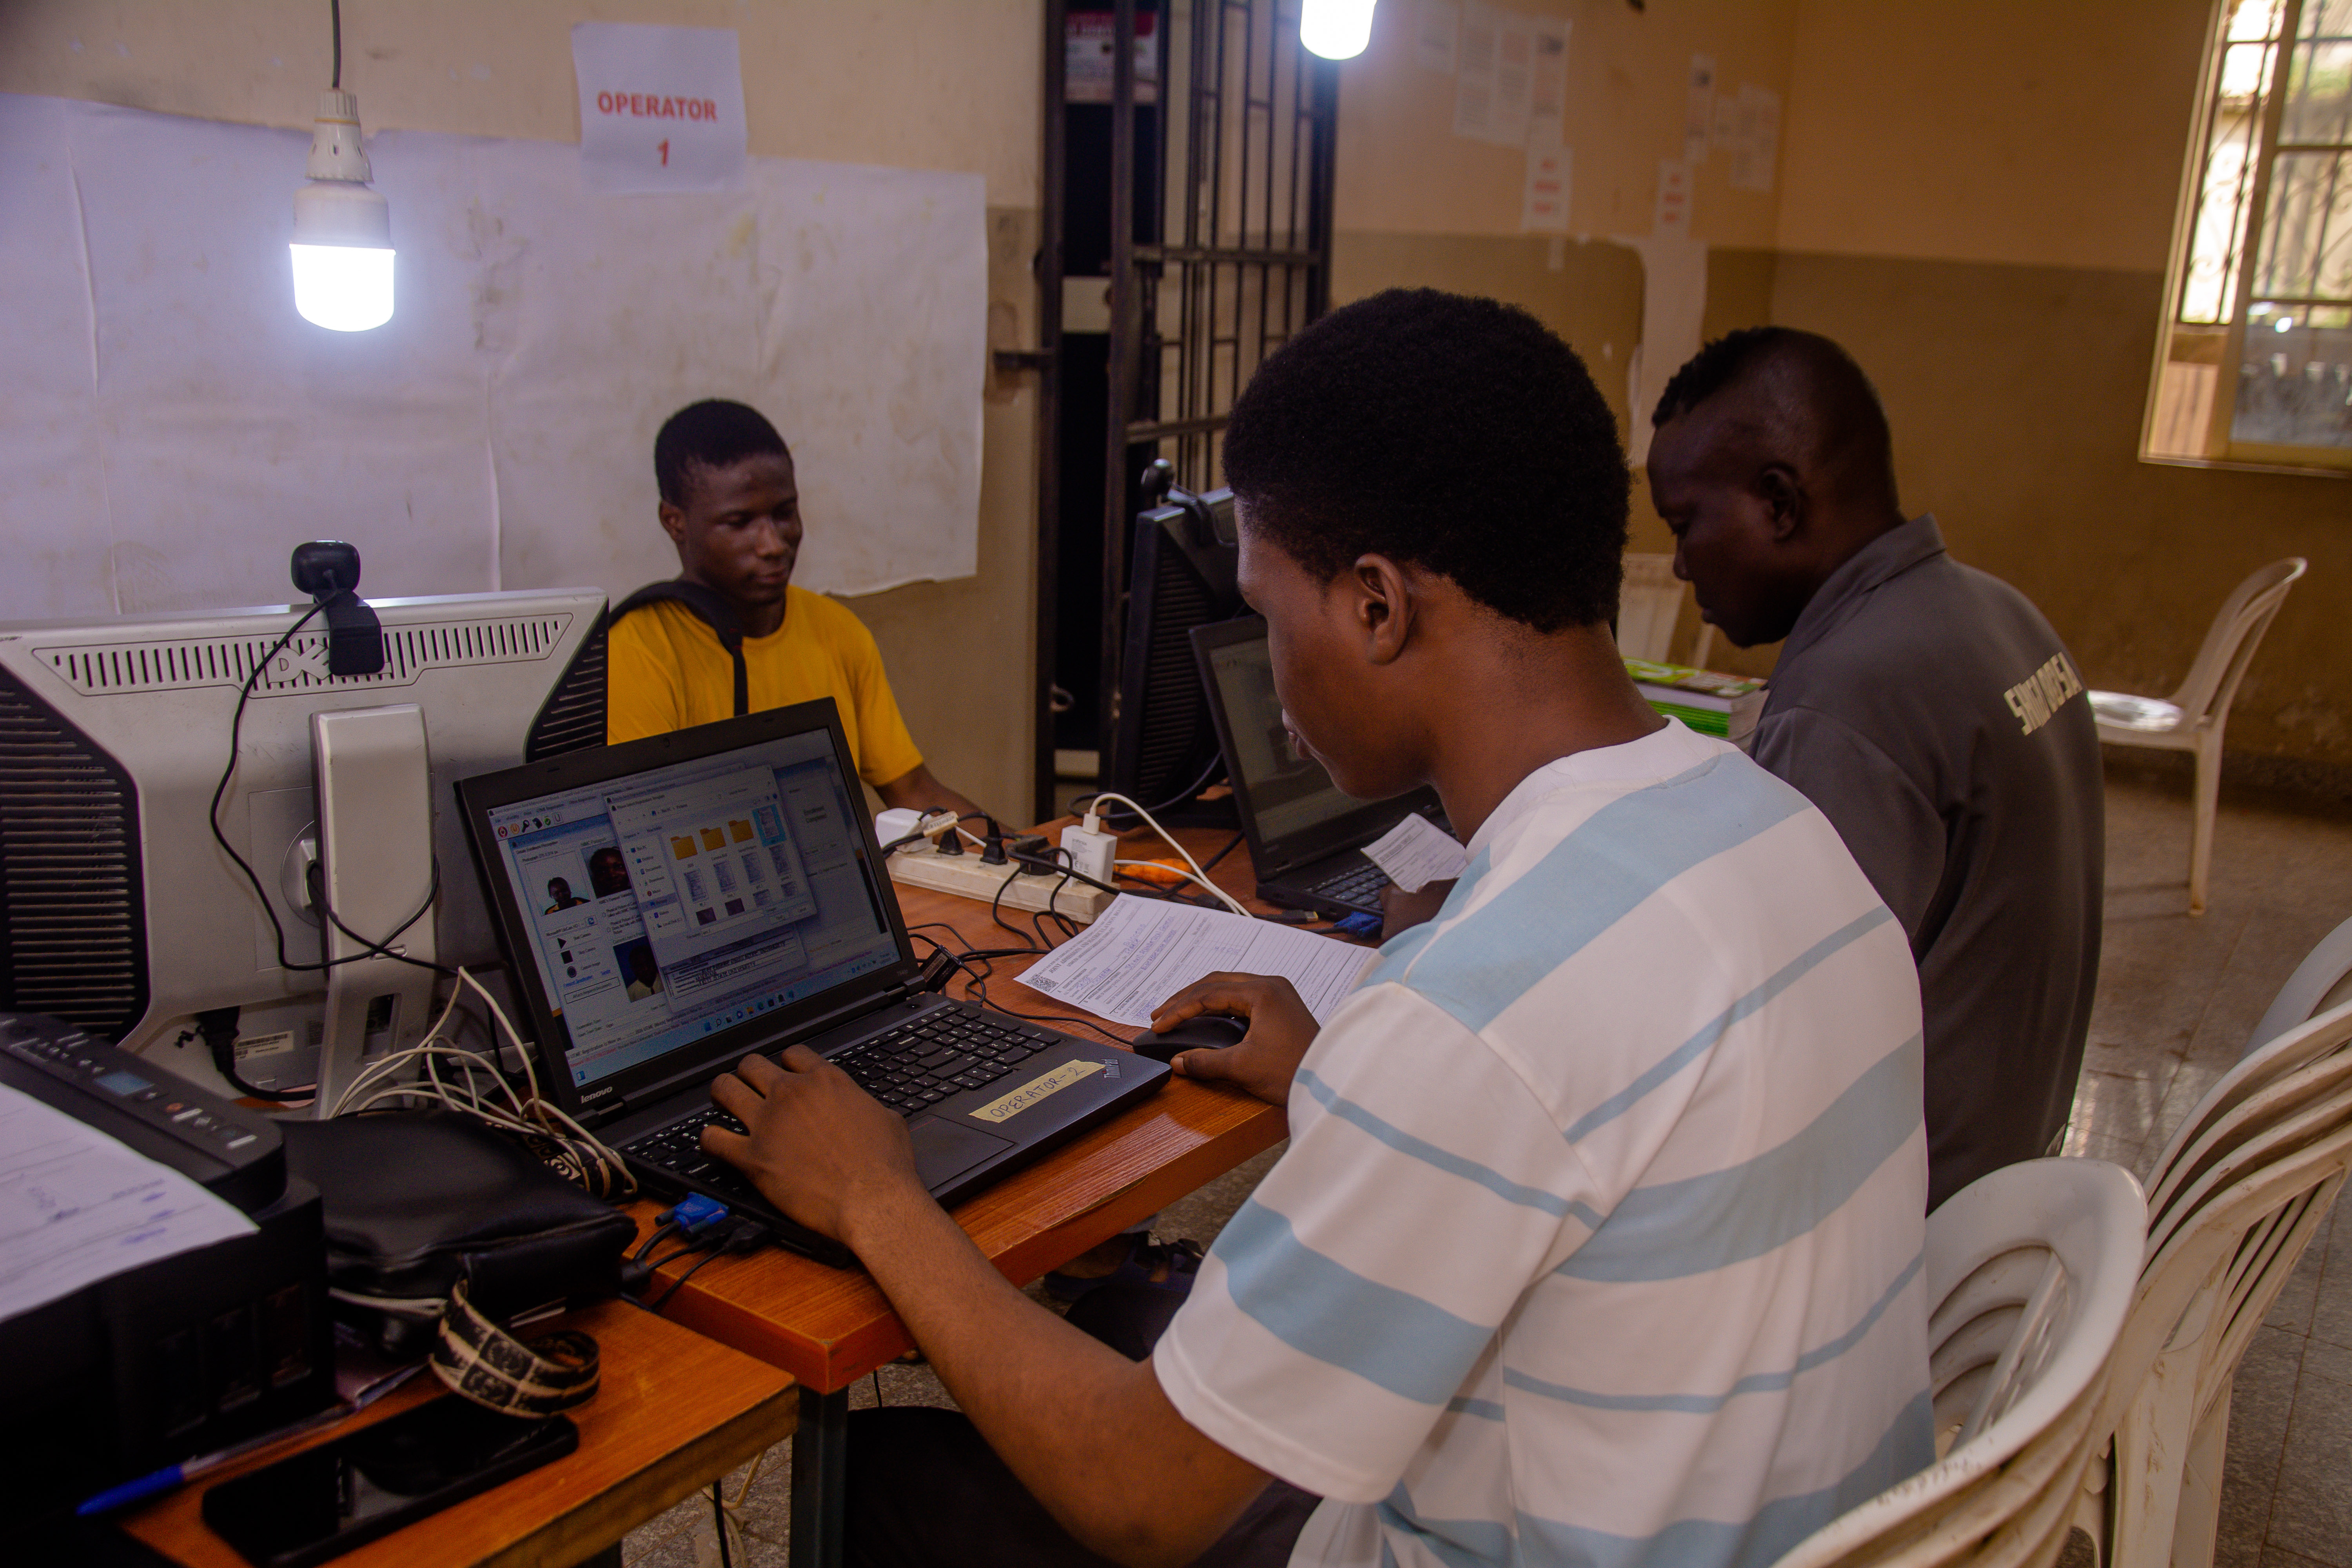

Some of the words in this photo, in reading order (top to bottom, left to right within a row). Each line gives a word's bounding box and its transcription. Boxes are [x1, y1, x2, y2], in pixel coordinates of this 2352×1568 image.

[597, 90, 718, 122] OPERATOR
[657, 138, 670, 167] 1
[1047, 963, 1063, 973] JOINT
[1058, 947, 1083, 964] ADMISSIONS
[1085, 916, 1117, 943] MATRICULATION
[1112, 902, 1127, 916] BOARD
[898, 1036, 915, 1045] Backspace
[1103, 1058, 1120, 1078] ThinkPad
[581, 1086, 613, 1104] lenovo
